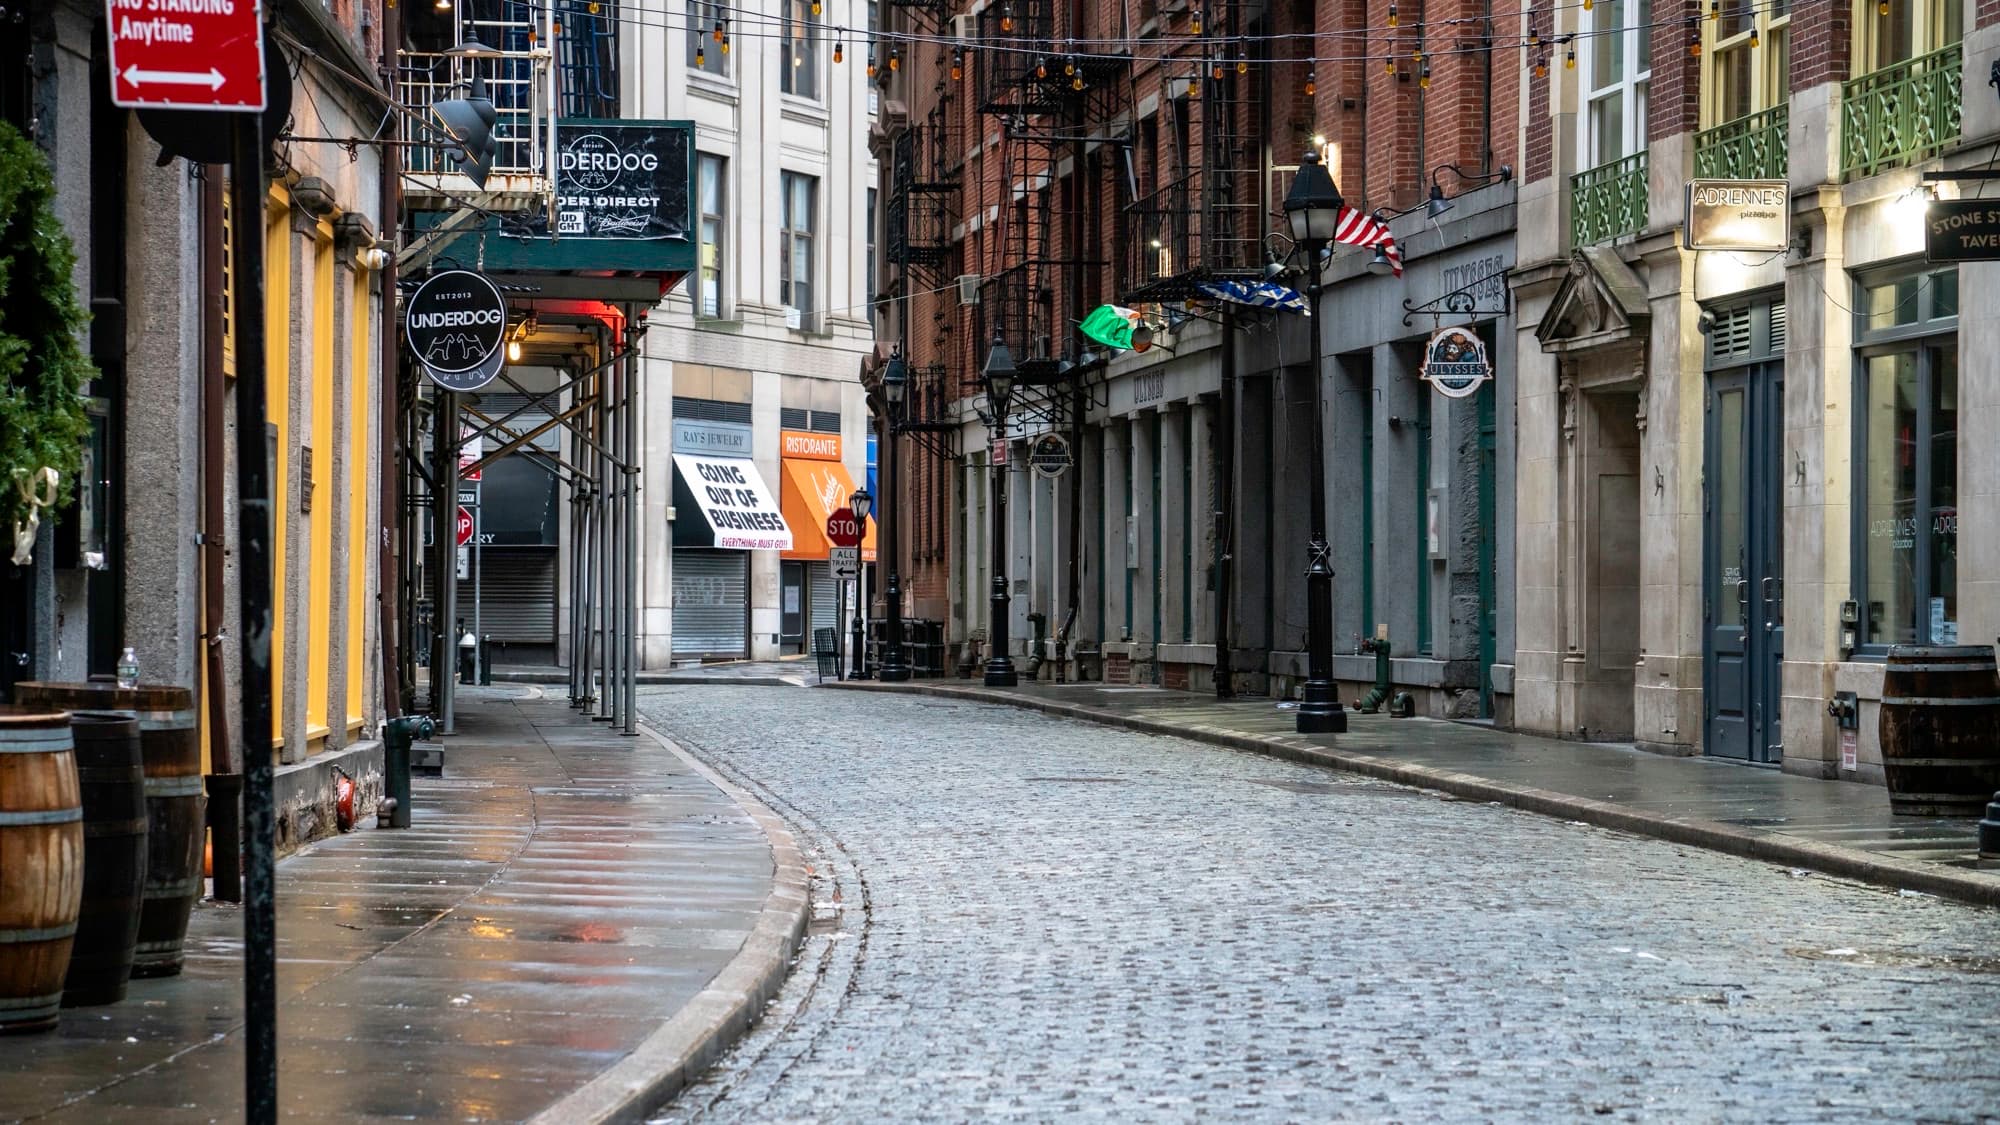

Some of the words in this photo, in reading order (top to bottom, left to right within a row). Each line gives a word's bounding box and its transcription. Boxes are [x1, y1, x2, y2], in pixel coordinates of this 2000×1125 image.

[120, 15, 194, 47] Anytime
[530, 152, 658, 171] UDERDOG
[597, 197, 660, 207] DIRECT
[1695, 187, 1785, 206] ADRIENNE'S
[1932, 211, 1983, 234] STONE
[1960, 233, 2000, 248] TAVE
[1443, 254, 1504, 304] ULYSSES
[411, 309, 501, 329] UNDERDOG
[1430, 364, 1483, 374] ULYSSES
[683, 431, 705, 443] RAY'S
[707, 433, 744, 447] JEWELRY
[786, 436, 837, 456] RISTORANTE
[696, 462, 746, 484] GOING
[705, 485, 736, 507] OUT
[735, 488, 759, 508] OF
[708, 508, 785, 531] BUSINESS
[721, 537, 757, 548] EVERYTHING
[758, 539, 774, 548] MUST
